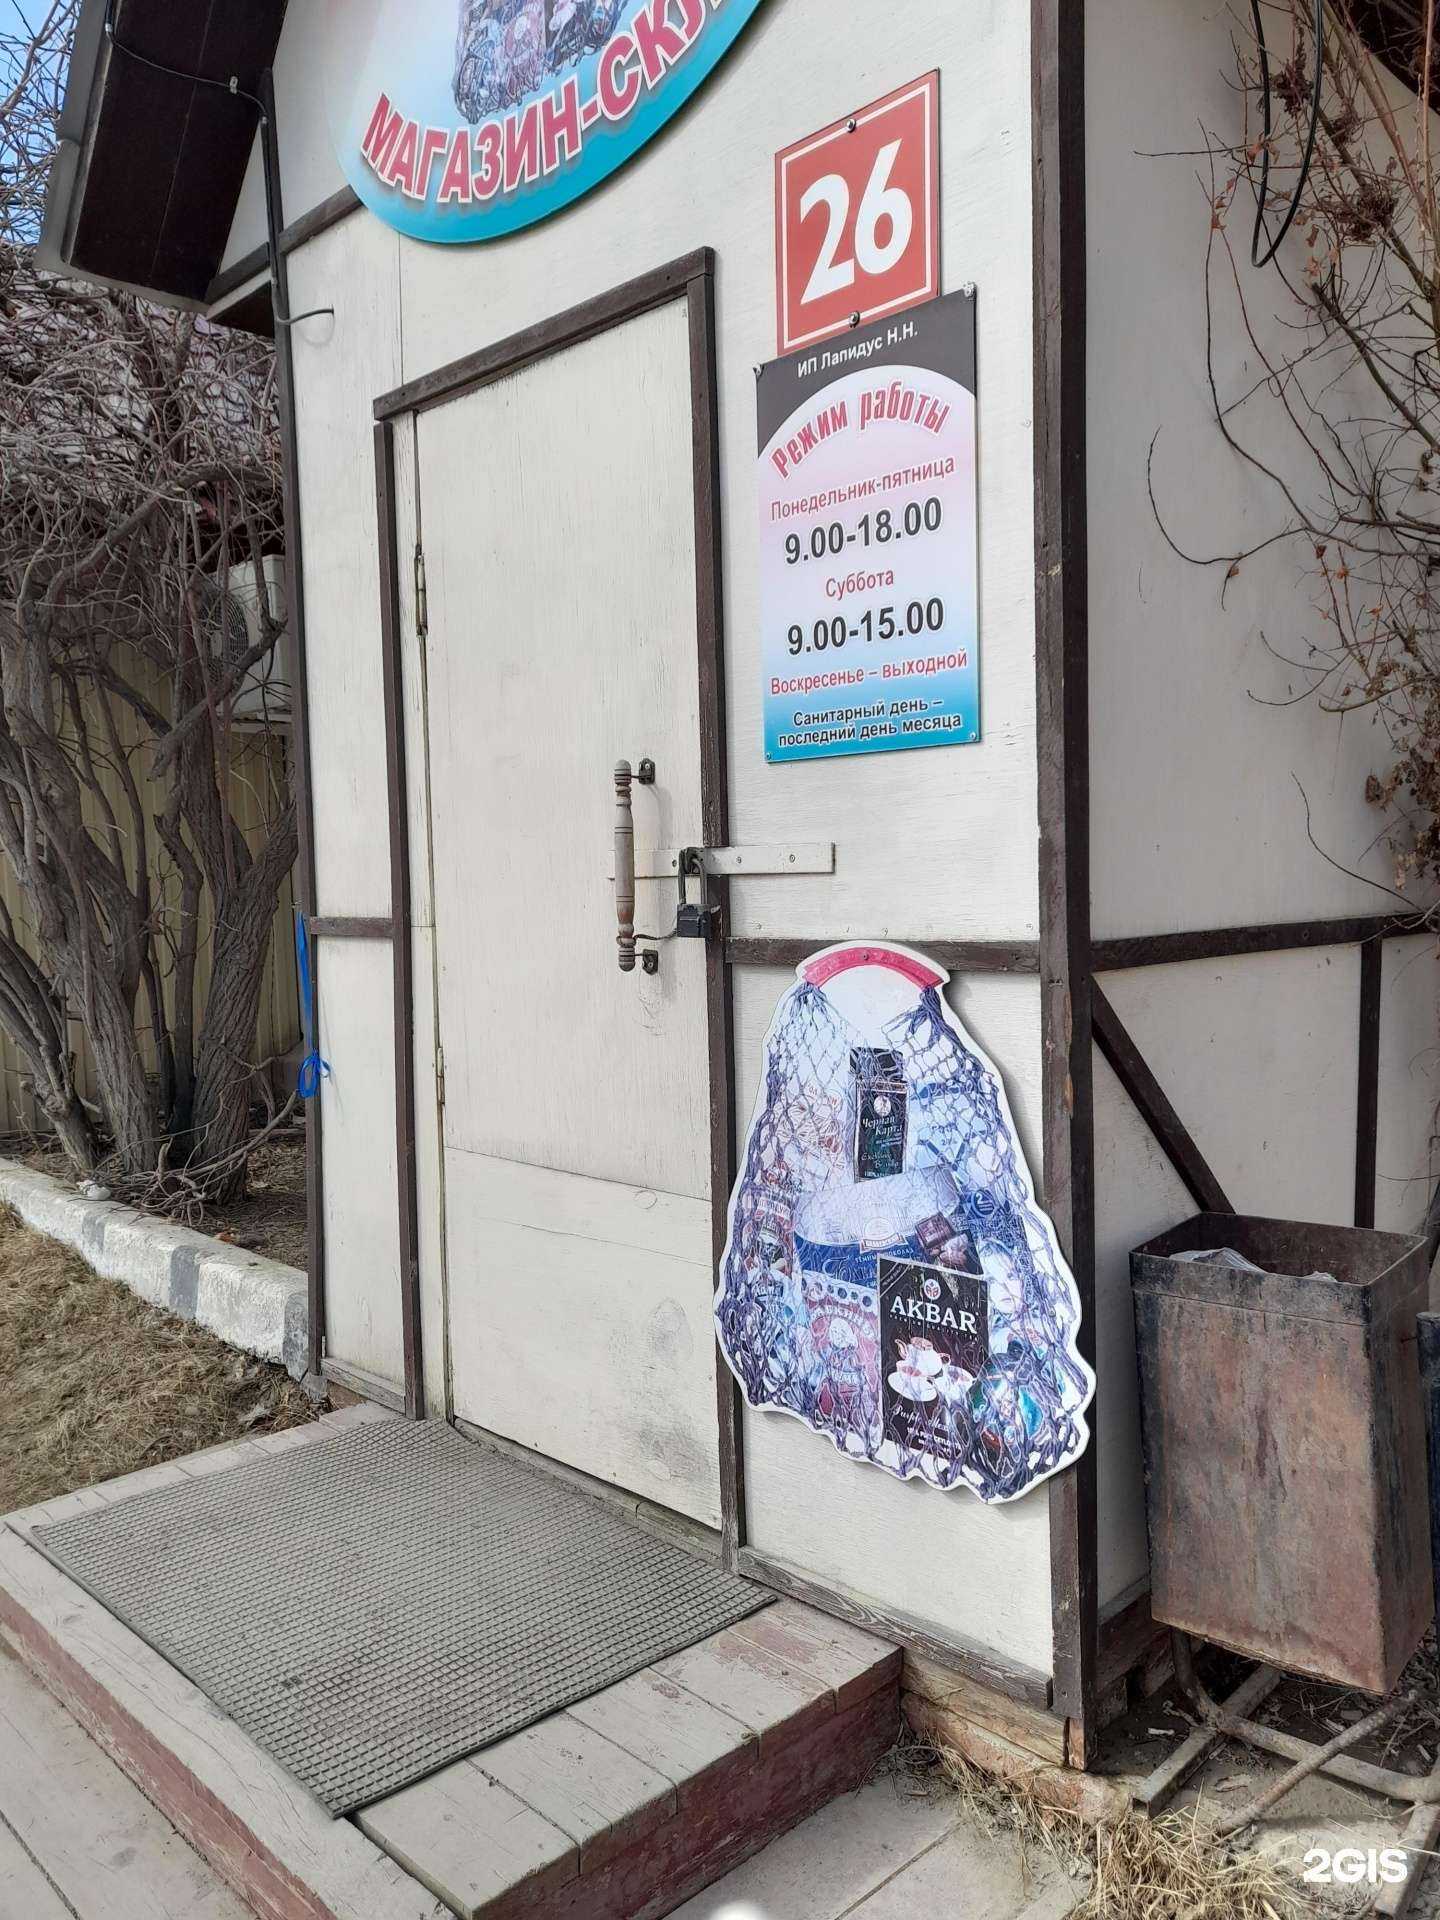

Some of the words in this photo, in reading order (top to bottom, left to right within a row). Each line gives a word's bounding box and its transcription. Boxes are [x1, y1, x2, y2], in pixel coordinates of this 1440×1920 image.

[800, 138, 912, 305] 26
[798, 358, 817, 378] ИП
[821, 336, 883, 369] Лапидус
[887, 321, 918, 346] Н.Н.
[771, 400, 848, 479] Режим
[860, 381, 950, 433] работы
[771, 456, 955, 520] Понедельник-пятница
[785, 497, 942, 564] 9.00-18.00
[825, 569, 894, 600] Суббота
[787, 597, 944, 655] 9.00-15.00
[771, 668, 864, 694] Воскресенье
[882, 648, 967, 679] выходной
[779, 723, 855, 746] последний
[860, 723, 897, 740] день
[902, 714, 961, 732] месяца
[793, 700, 885, 726] Санитарный
[889, 698, 928, 716] день
[890, 1295, 978, 1334] AKBAR
